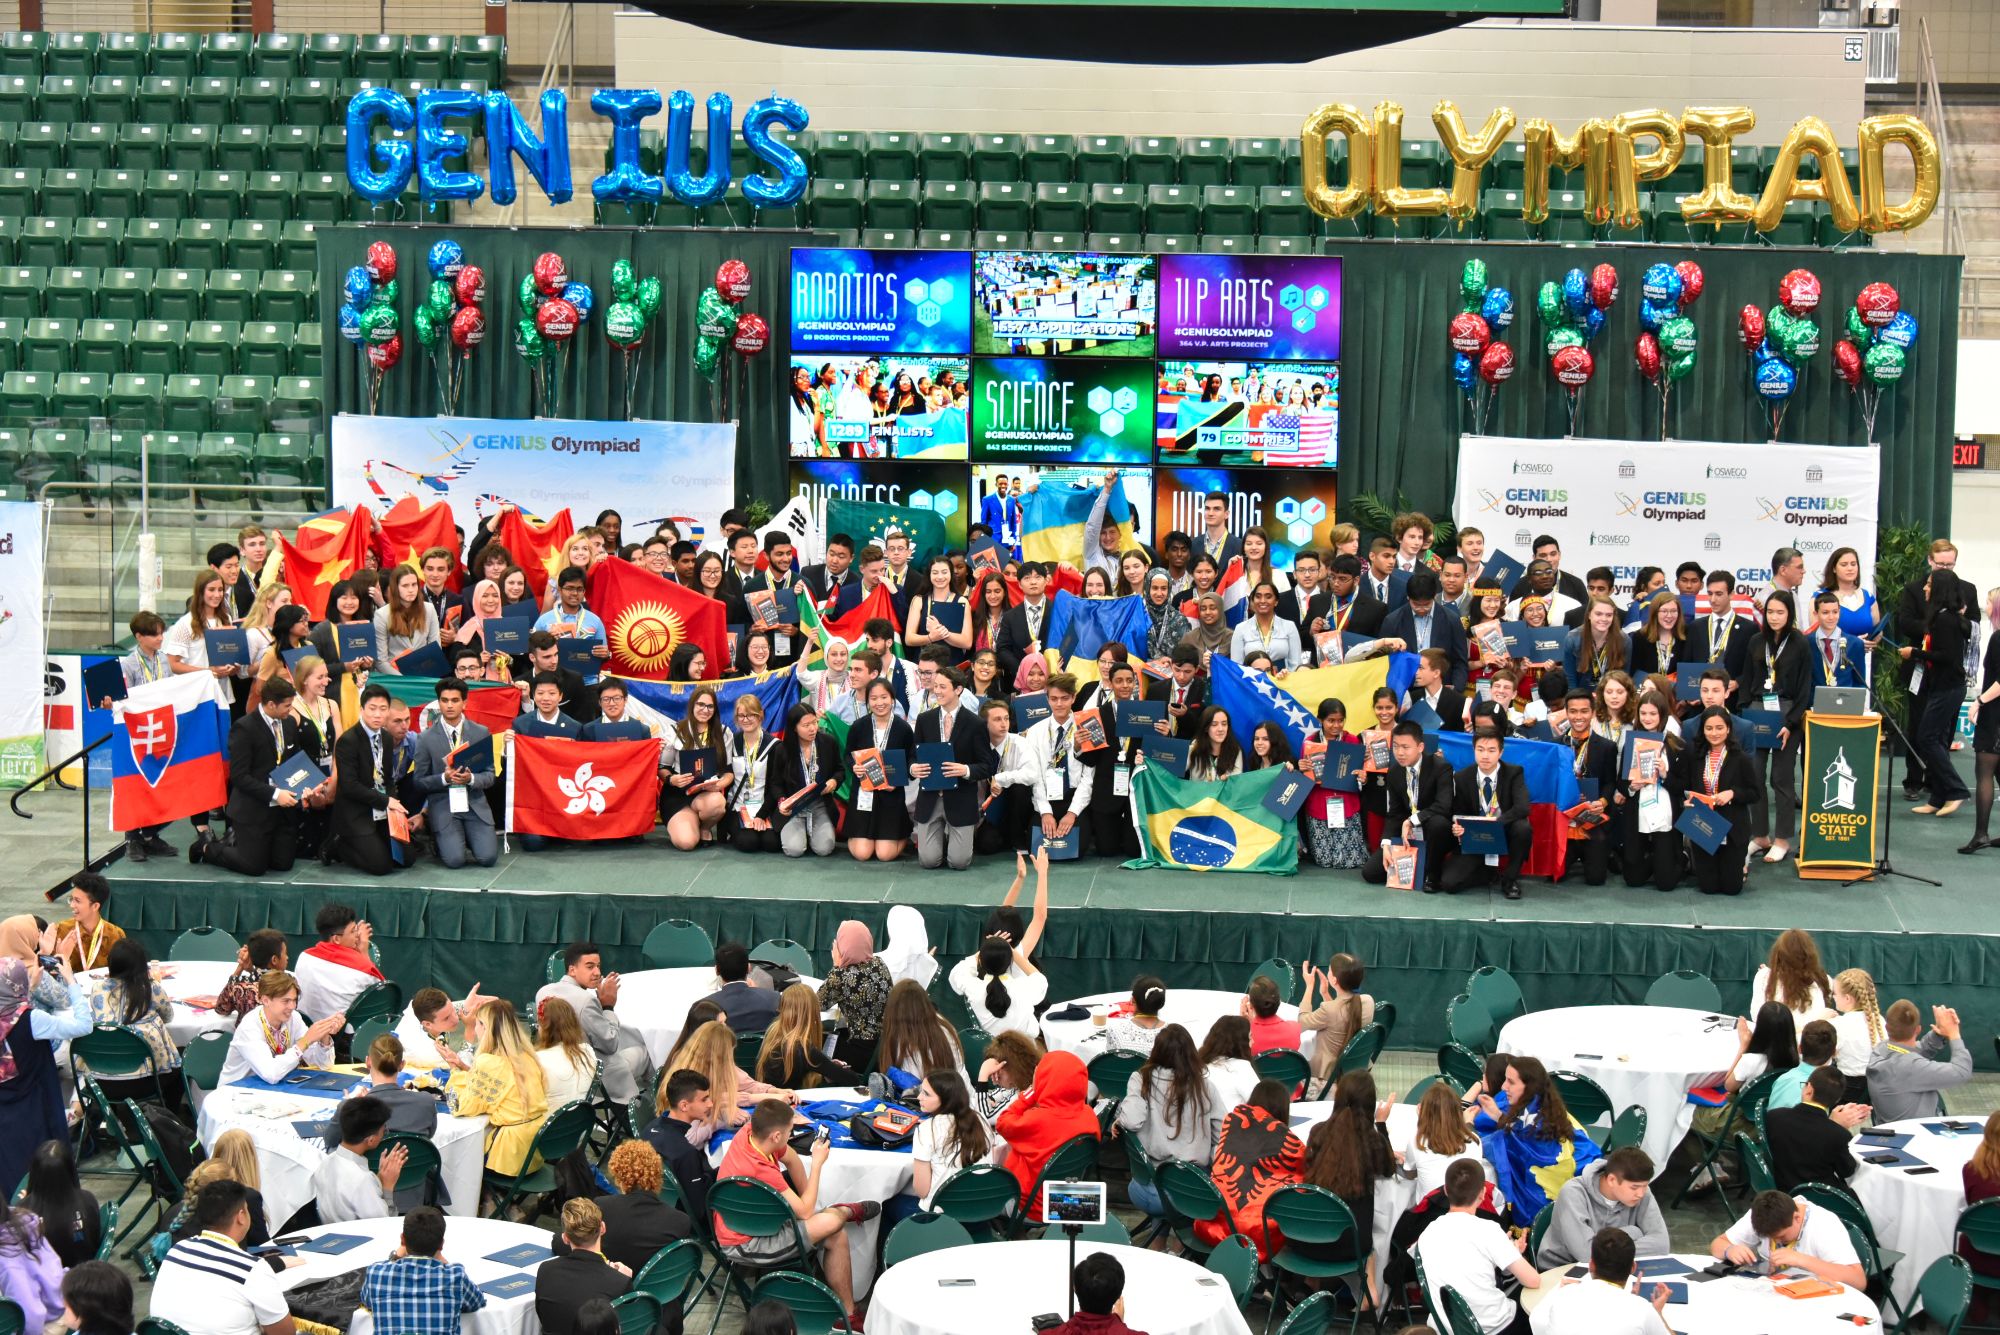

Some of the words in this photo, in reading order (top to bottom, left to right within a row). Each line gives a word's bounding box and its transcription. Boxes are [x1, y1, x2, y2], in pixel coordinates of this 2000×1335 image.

[1845, 44, 1862, 60] 53
[346, 87, 809, 208] GENIUS
[1301, 99, 1940, 233] OLYMPIAD
[796, 271, 898, 321] ROBOTICS
[1220, 278, 1274, 327] ARTS
[798, 321, 896, 331] #GENIUSOLYMPIAD
[1026, 321, 1137, 335] APPLICATIONS
[1174, 328, 1274, 338] #GENIUSOLYMPIAD
[736, 338, 763, 346] GENIUS
[1453, 338, 1479, 346] GENIUS
[986, 380, 1075, 432] SCIENCE
[830, 424, 864, 437] 1289
[871, 426, 934, 438] FINALISTS
[985, 431, 1074, 441] #GENIUSOLYMPIAD
[1201, 433, 1216, 442] 79
[473, 435, 547, 451] GENIUS
[551, 436, 641, 456] Olympiad
[1034, 444, 1072, 452] PROJECTS
[1953, 445, 1980, 465] EXIT
[1521, 463, 1553, 473] OSWEGO
[1714, 467, 1747, 477] OSWEGO
[1505, 488, 1569, 503] GENIUS
[1643, 491, 1707, 506] GENIUS
[1785, 496, 1849, 511] GENIUS
[1505, 504, 1568, 519] Olympiad
[1643, 507, 1706, 522] Olympiad
[1784, 512, 1848, 527] Olympiad
[1598, 535, 1630, 544] OSWEGO
[1800, 541, 1833, 550] OSWEGO
[1736, 568, 1772, 581] GEN
[1810, 813, 1867, 825] OSWEGO
[1819, 825, 1857, 837] STATE
